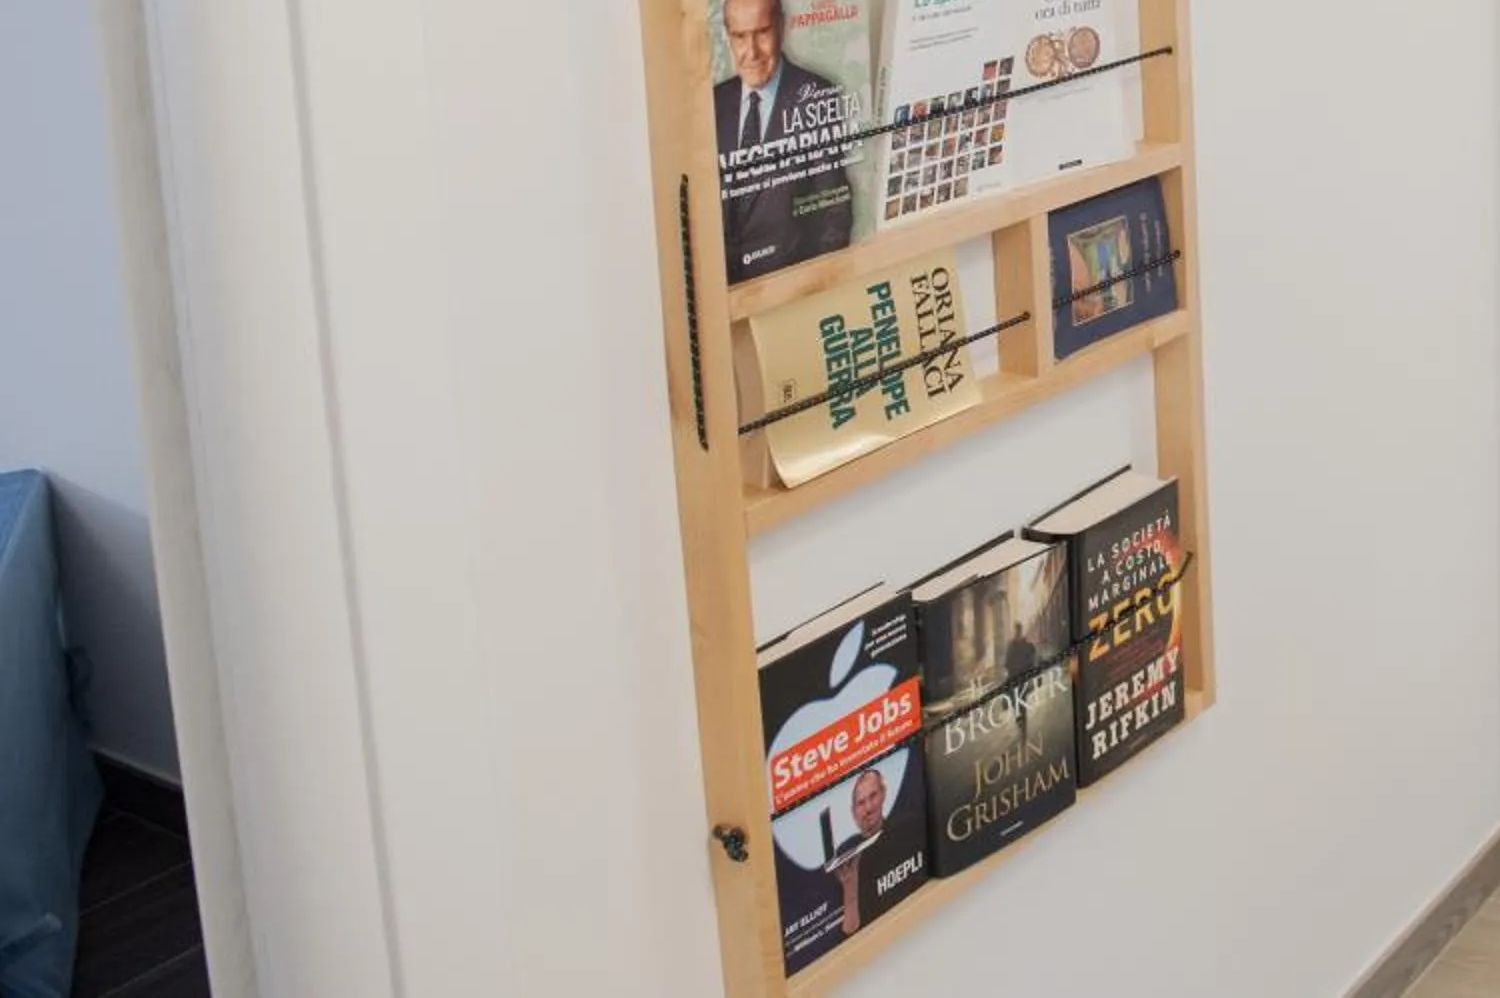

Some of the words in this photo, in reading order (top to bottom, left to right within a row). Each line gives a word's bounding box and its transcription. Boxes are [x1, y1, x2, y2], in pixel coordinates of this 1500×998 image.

[782, 106, 804, 134] LA
[805, 91, 860, 130] SCELTA
[931, 267, 966, 395] ORIANA
[1088, 553, 1105, 573] LA
[1112, 508, 1171, 560] SOCIETÀ
[1102, 568, 1111, 584] A
[1115, 540, 1162, 577] COSTO
[1088, 569, 1177, 663] ZERO
[943, 665, 1068, 757] BROKER
[1085, 645, 1179, 731] JEREMY
[1092, 680, 1177, 761] RIFKIN
[774, 731, 850, 790] Steve
[854, 692, 913, 744] Jobs
[974, 731, 1044, 801] JOHN
[947, 755, 1071, 842] GRISHAM
[876, 851, 923, 897] HOEPLI
